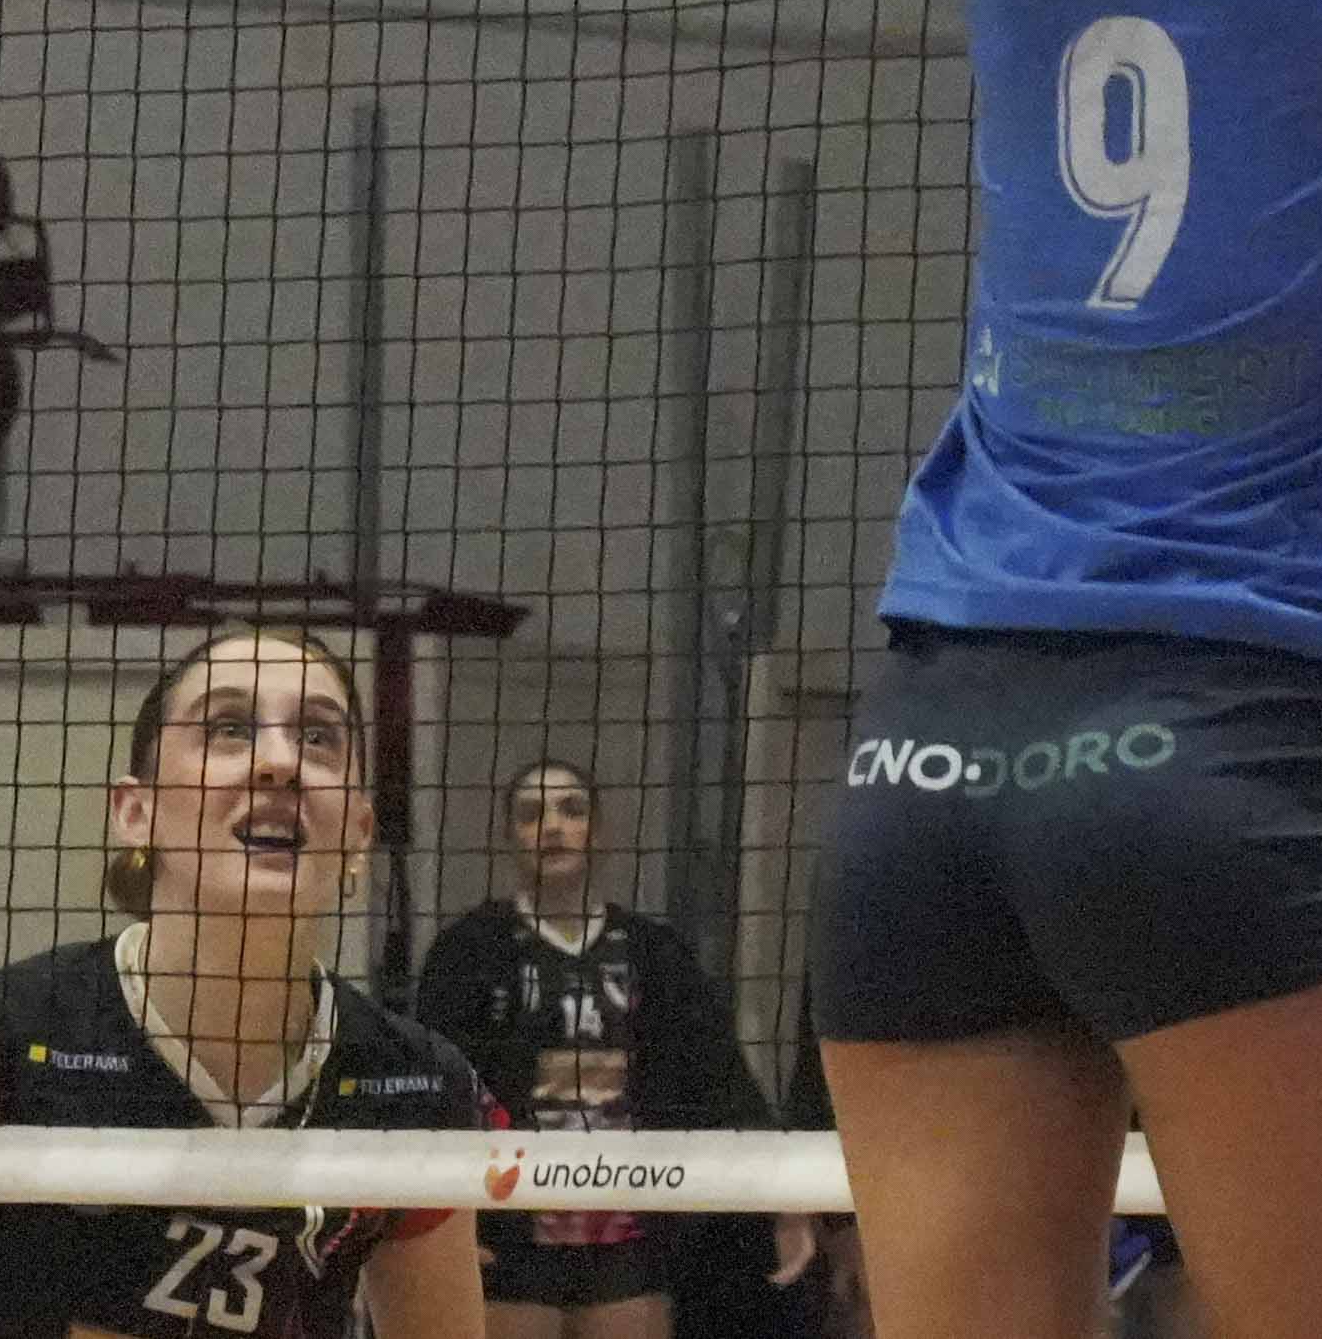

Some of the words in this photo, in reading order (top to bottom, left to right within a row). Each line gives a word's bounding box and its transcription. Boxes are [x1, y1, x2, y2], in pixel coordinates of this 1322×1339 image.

[1058, 16, 1191, 310] 9
[534, 1154, 685, 1188] unobravo
[143, 1220, 278, 1333] 23
